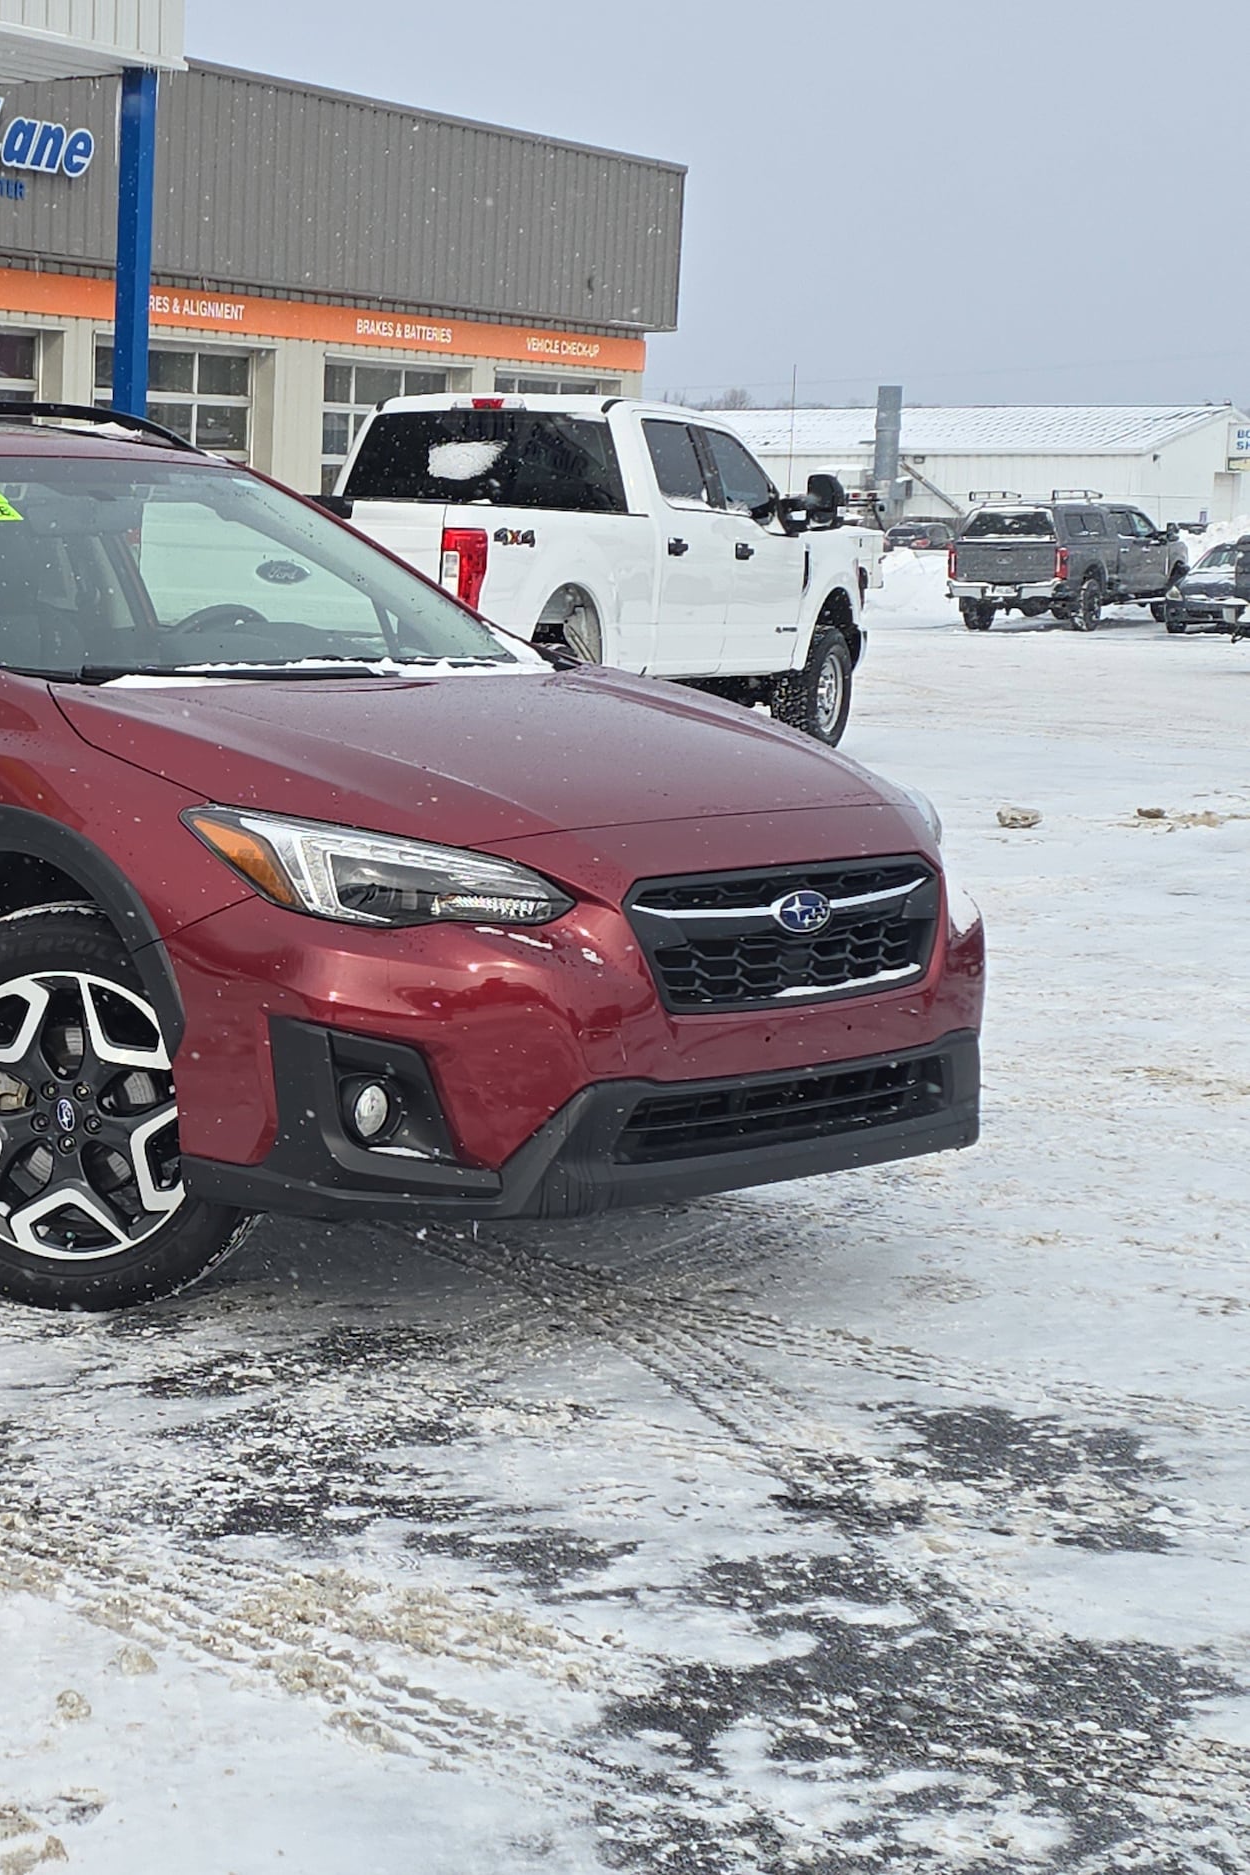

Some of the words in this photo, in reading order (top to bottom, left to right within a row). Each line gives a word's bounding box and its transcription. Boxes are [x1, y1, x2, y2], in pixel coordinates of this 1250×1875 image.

[149, 294, 170, 313] RES
[172, 297, 181, 314] &
[182, 298, 245, 321] ALIGNMENT
[356, 318, 394, 338] BRAKES
[395, 325, 402, 338] &
[404, 324, 453, 343] BATTERIES
[526, 337, 560, 354] VEHICLE
[560, 339, 600, 358] CHECK-UP
[267, 565, 298, 579] Ford
